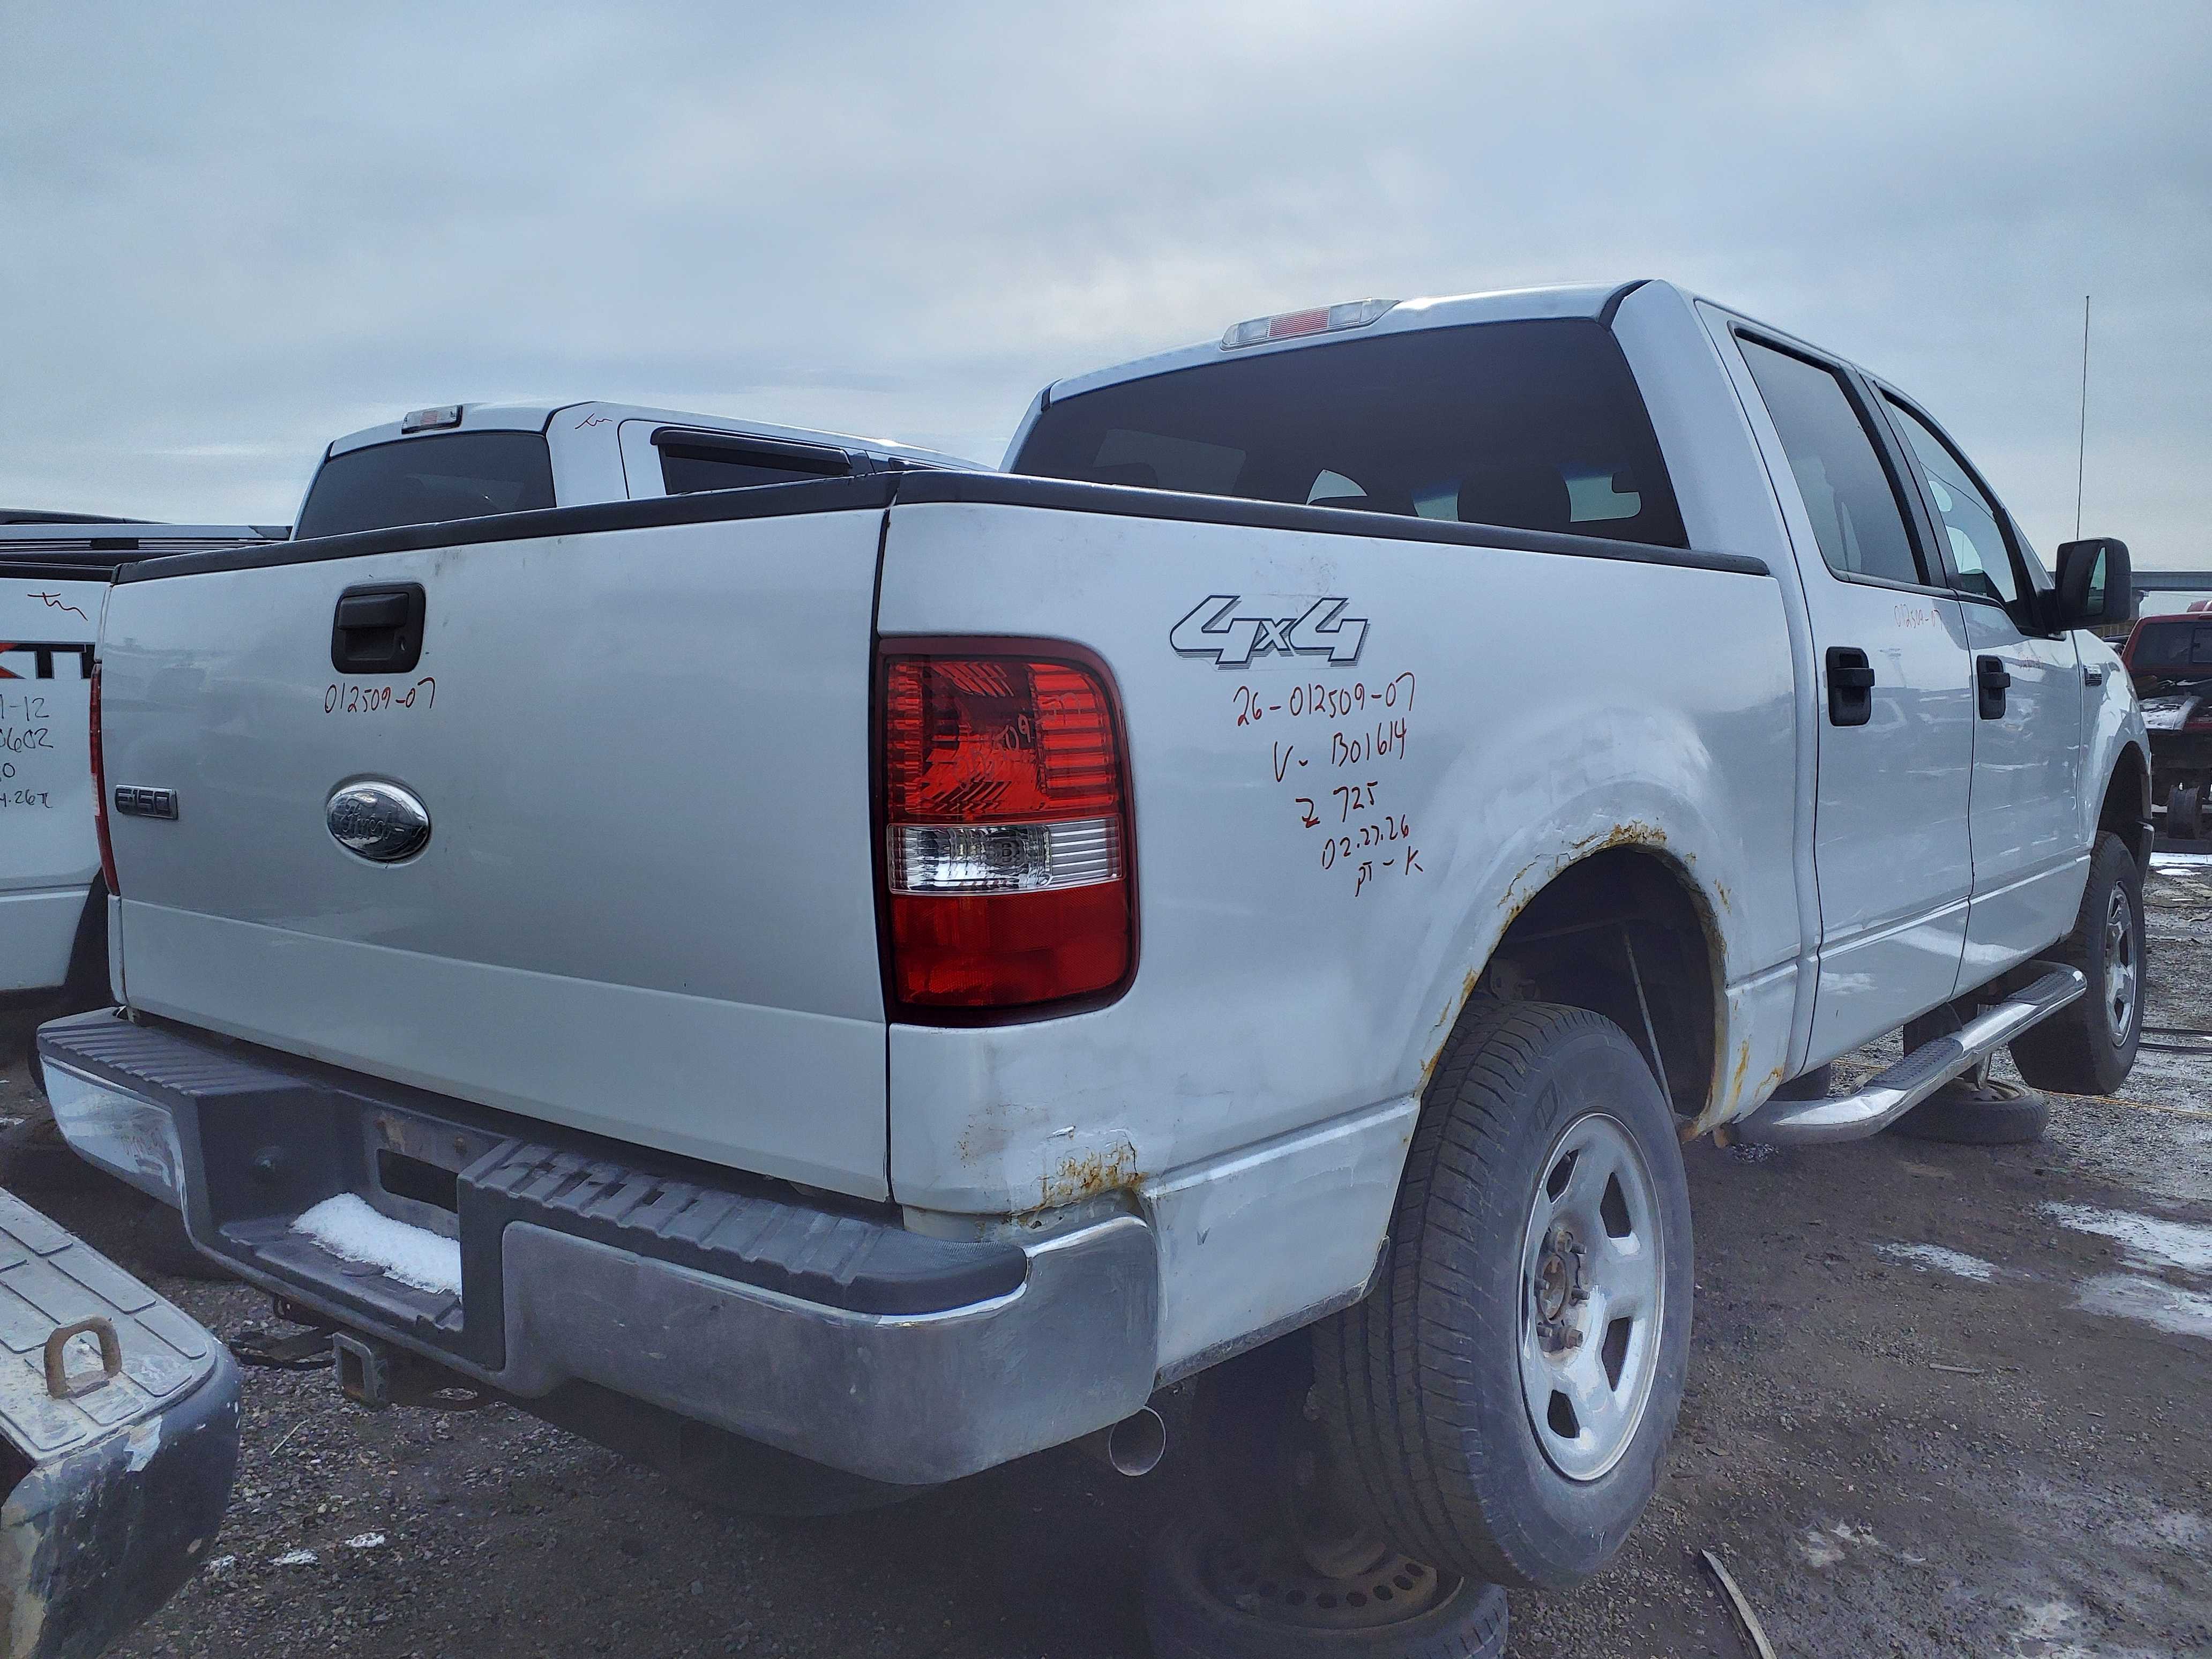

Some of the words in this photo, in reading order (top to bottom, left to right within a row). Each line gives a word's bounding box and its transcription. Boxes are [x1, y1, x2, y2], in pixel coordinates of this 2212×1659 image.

[324, 677, 435, 713] 012509-07
[1234, 672, 1415, 726] 26-012509-07
[1333, 781, 1378, 823] 725
